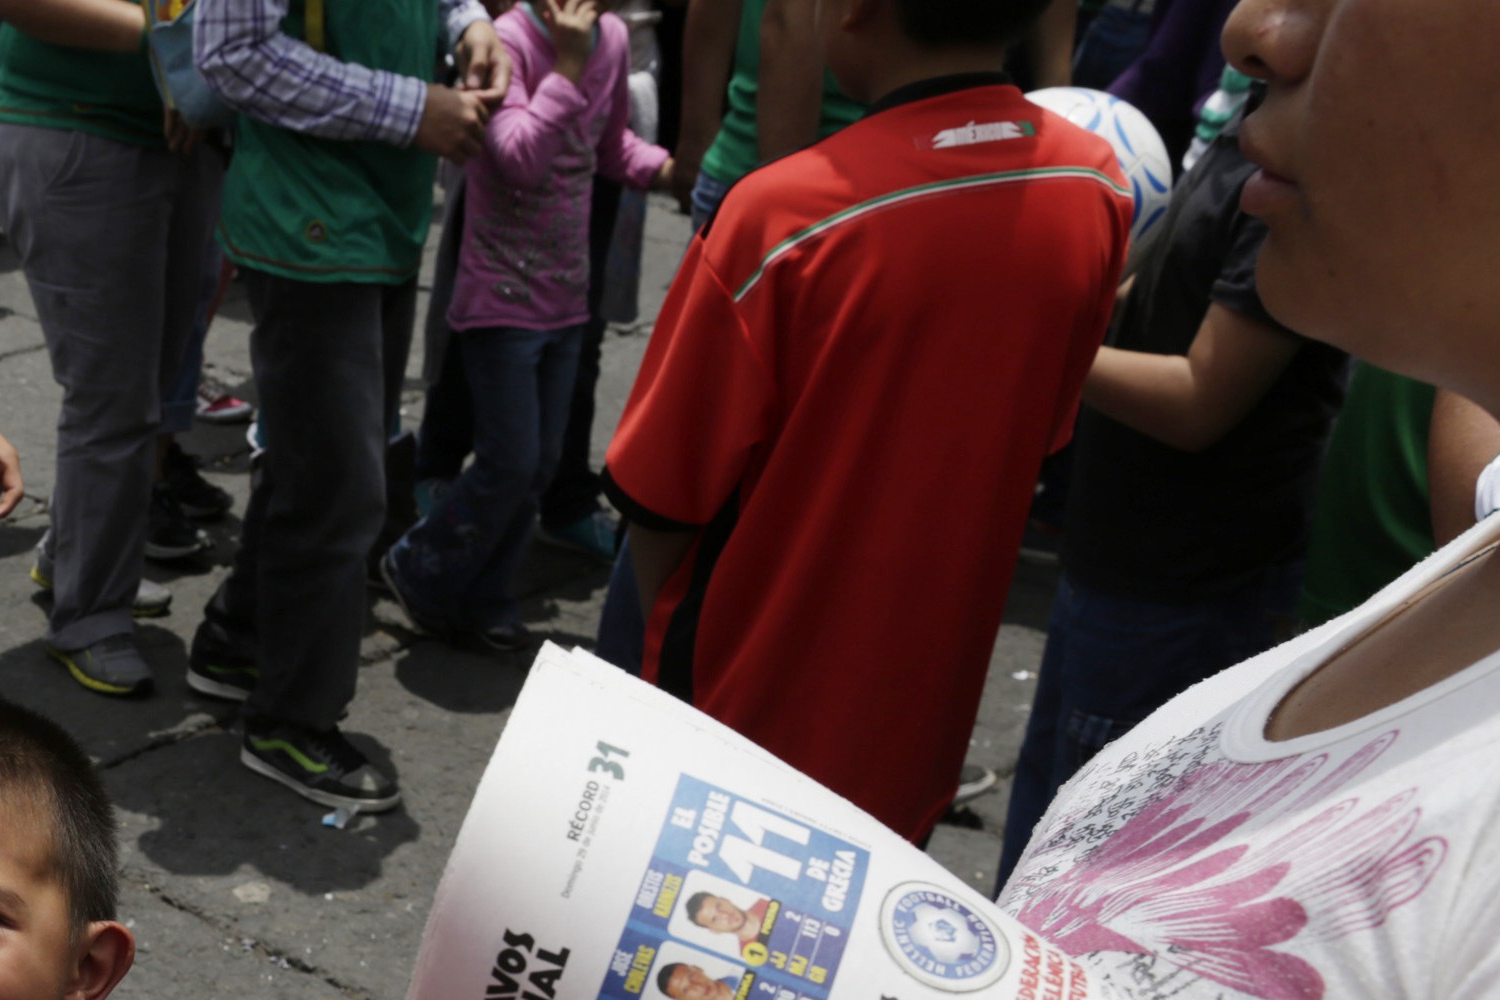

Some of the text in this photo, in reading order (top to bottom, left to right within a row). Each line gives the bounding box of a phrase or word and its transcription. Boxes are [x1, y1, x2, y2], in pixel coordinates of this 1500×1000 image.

[563, 739, 634, 842] RÉCORD 31
[669, 802, 698, 831] EL
[687, 790, 731, 867] POSIBLE
[715, 799, 812, 884] 11
[560, 858, 584, 899] Domingo
[804, 855, 832, 882] DE
[820, 847, 857, 913] GRECIA
[767, 909, 802, 970] JJ 2
[787, 916, 822, 977] MJ 113
[955, 912, 994, 974] FEDERATION
[758, 980, 777, 994] 2
